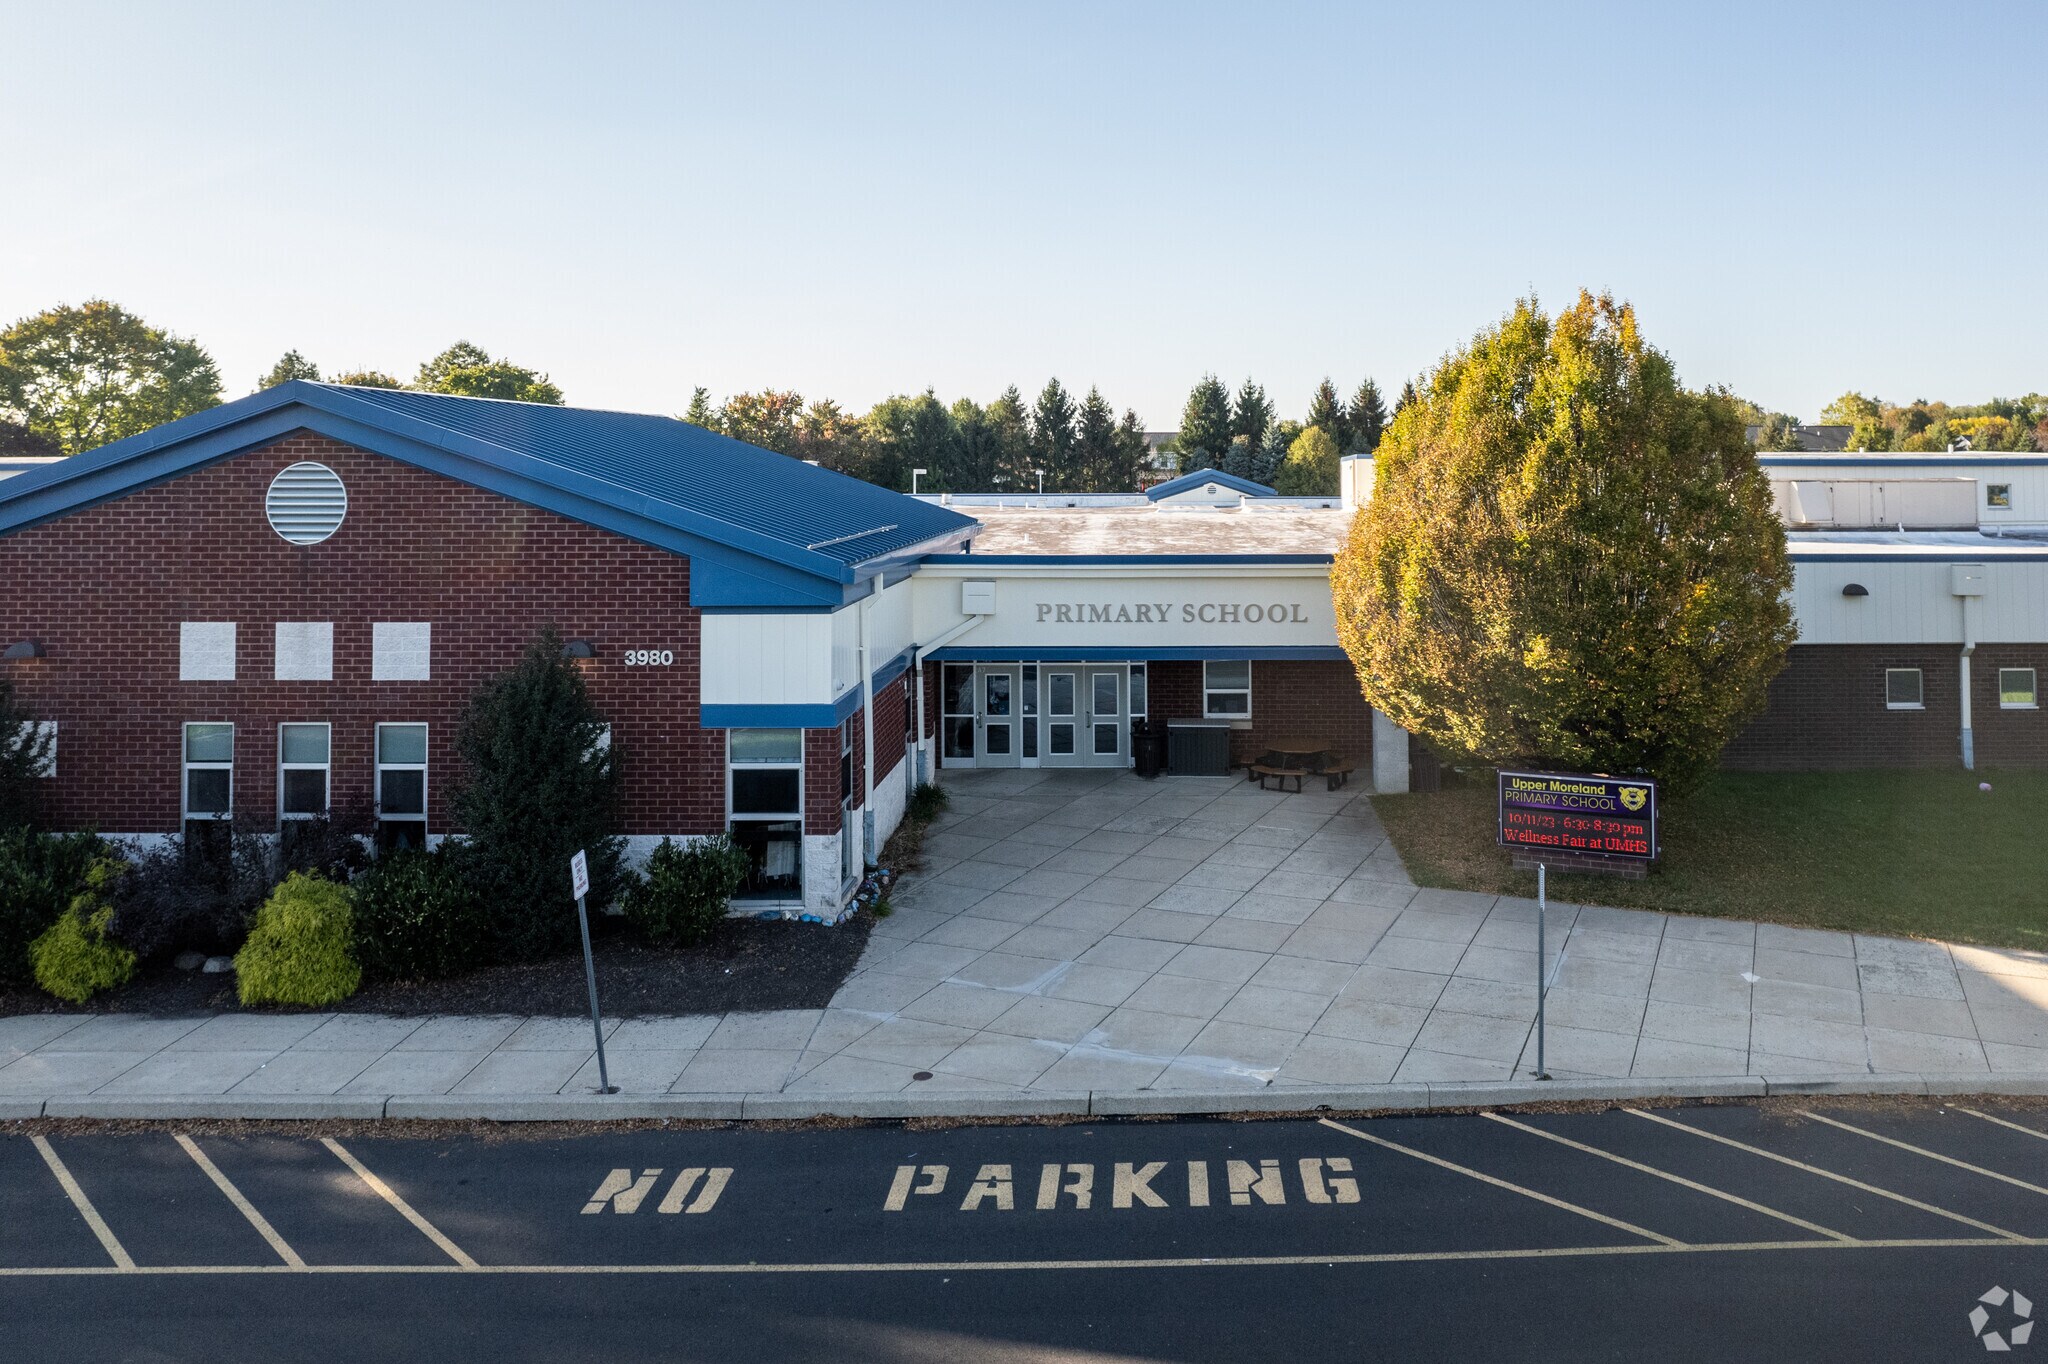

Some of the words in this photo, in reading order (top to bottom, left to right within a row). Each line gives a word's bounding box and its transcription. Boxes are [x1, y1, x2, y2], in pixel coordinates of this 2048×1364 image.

[1035, 603, 1173, 623] PRIMARY
[1182, 603, 1309, 623] SCHOOL
[624, 650, 673, 666] 3980
[1512, 778, 1547, 792] Upper
[1549, 781, 1606, 795] Moreland
[1505, 790, 1558, 805] PRIMARY
[1562, 795, 1616, 811] SCHOOL
[1504, 828, 1559, 845] Wellness
[1562, 834, 1587, 847] Fair
[1589, 838, 1602, 849] at
[1605, 838, 1648, 853] UMHS
[1623, 823, 1643, 838] pm
[579, 1167, 735, 1215] NO
[883, 1157, 1362, 1212] PARKING
